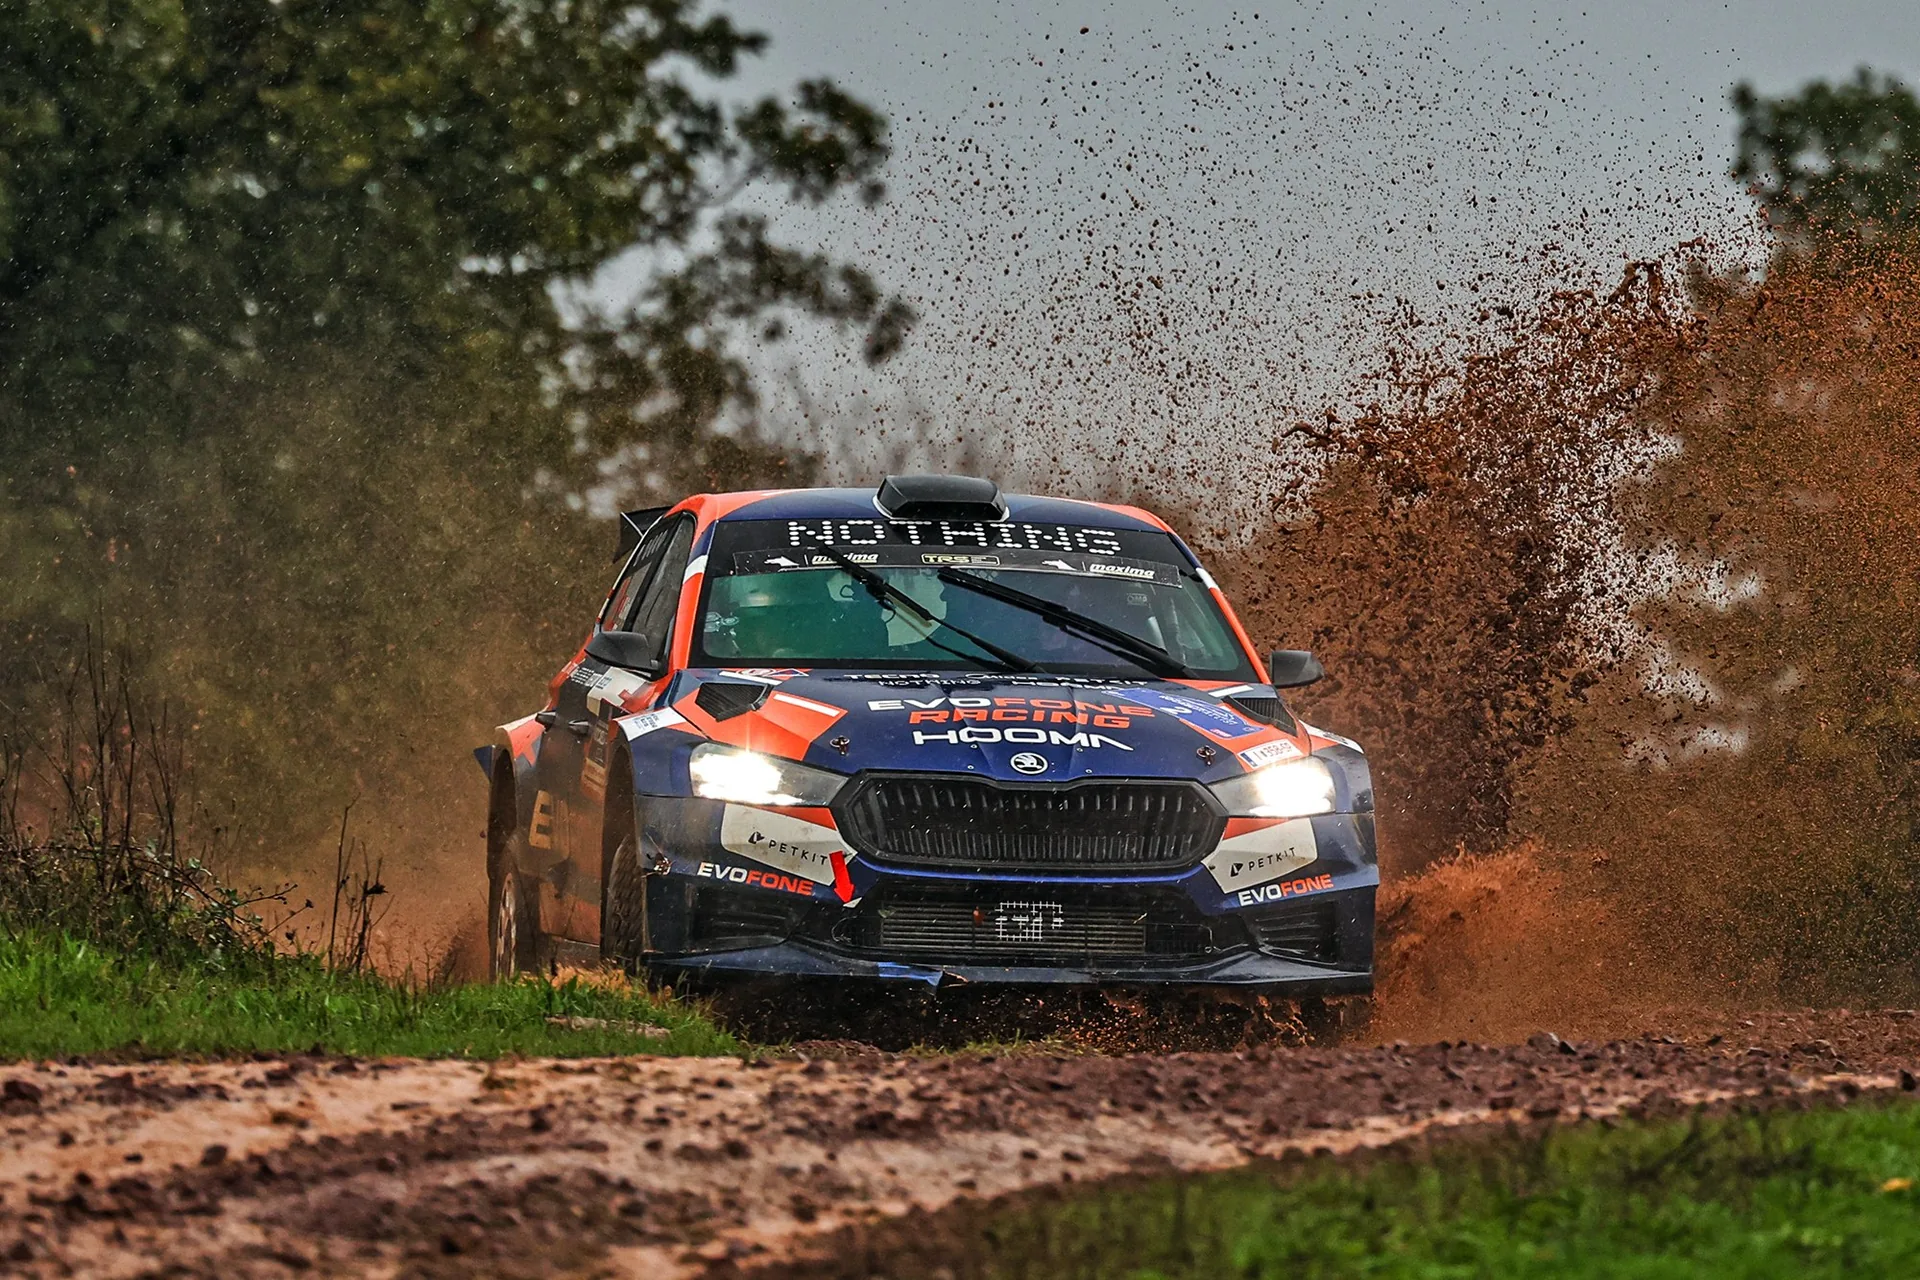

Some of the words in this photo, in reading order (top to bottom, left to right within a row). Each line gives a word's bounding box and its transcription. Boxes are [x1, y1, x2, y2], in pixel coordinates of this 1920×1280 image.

[788, 520, 1121, 555] NOTHING
[1090, 563, 1155, 578] maxima
[868, 697, 1155, 717] EVOFONE
[909, 708, 1130, 729] RACING
[913, 726, 1134, 751] HOOMA
[769, 839, 828, 866] PETKIT
[1248, 847, 1296, 871] PETKIT
[697, 862, 815, 896] EVOFONE
[1237, 873, 1334, 907] EVOFONE
